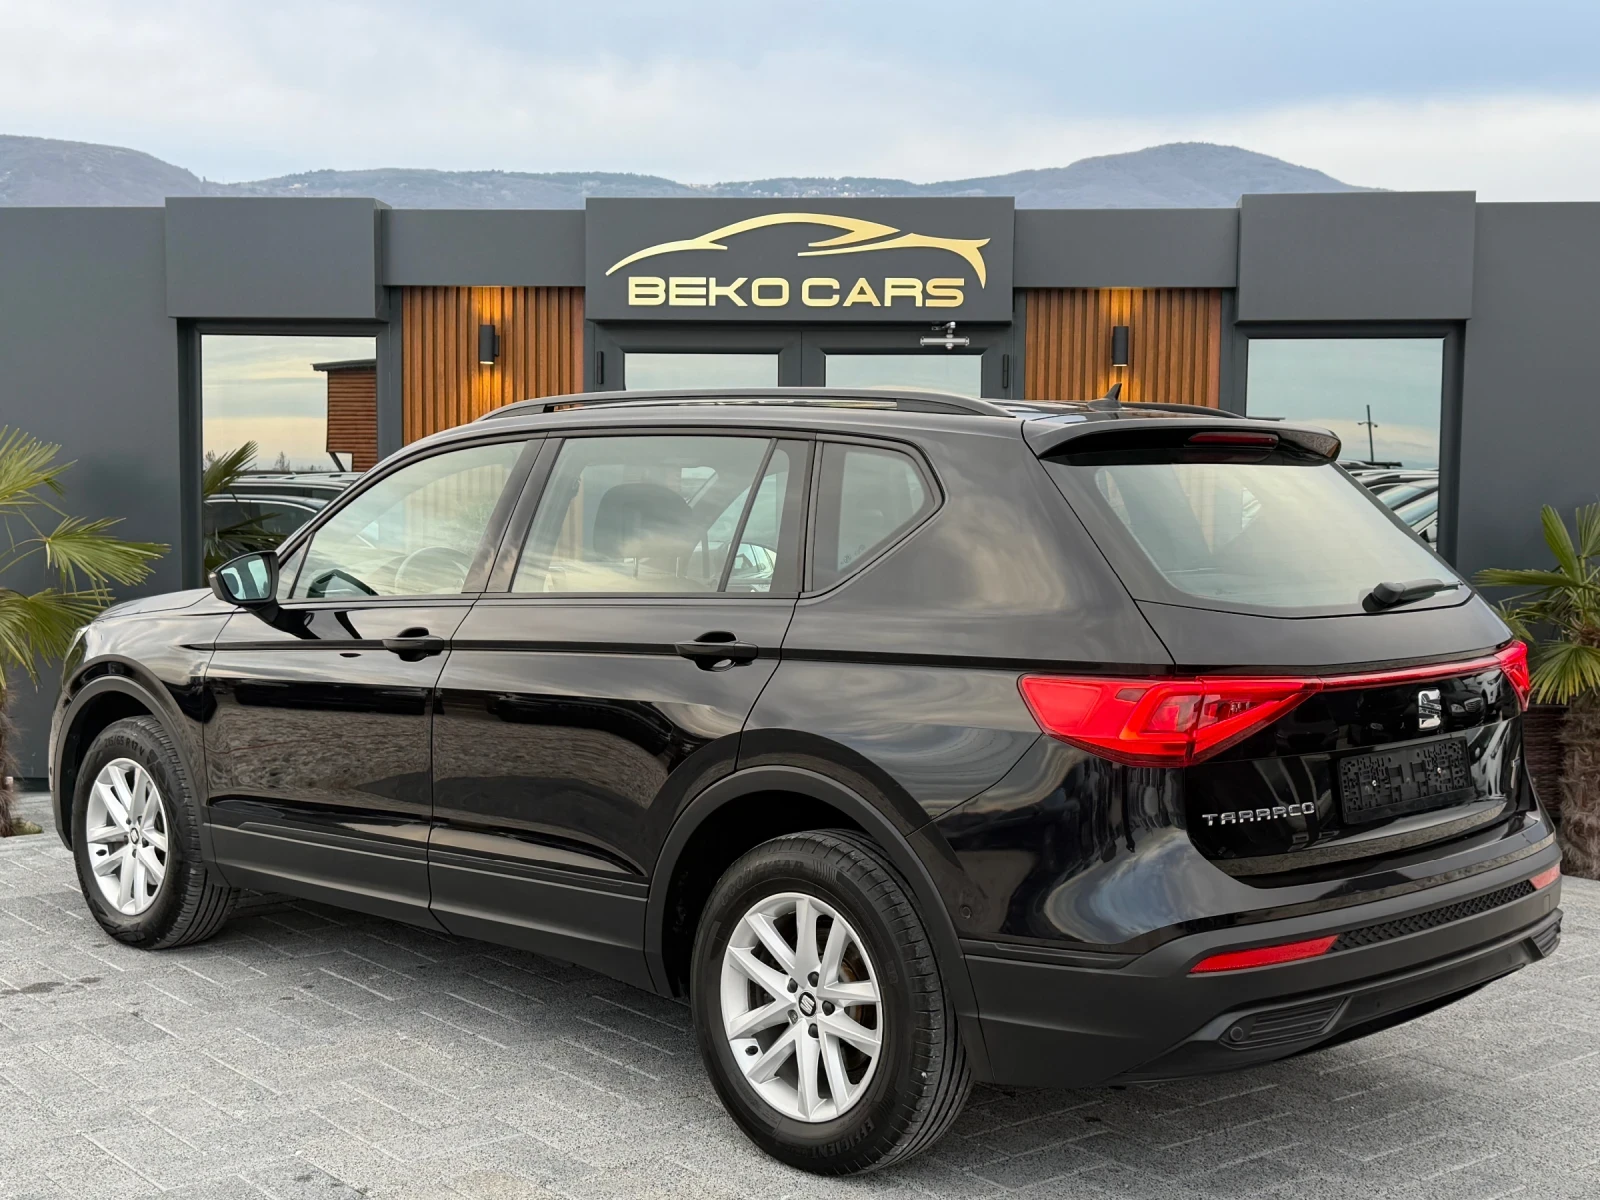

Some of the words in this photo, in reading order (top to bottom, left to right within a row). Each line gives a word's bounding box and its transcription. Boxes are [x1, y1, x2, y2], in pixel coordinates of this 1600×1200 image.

[628, 276, 790, 306] BEKO
[801, 277, 965, 307] CARS
[1201, 801, 1315, 827] TARRACO
